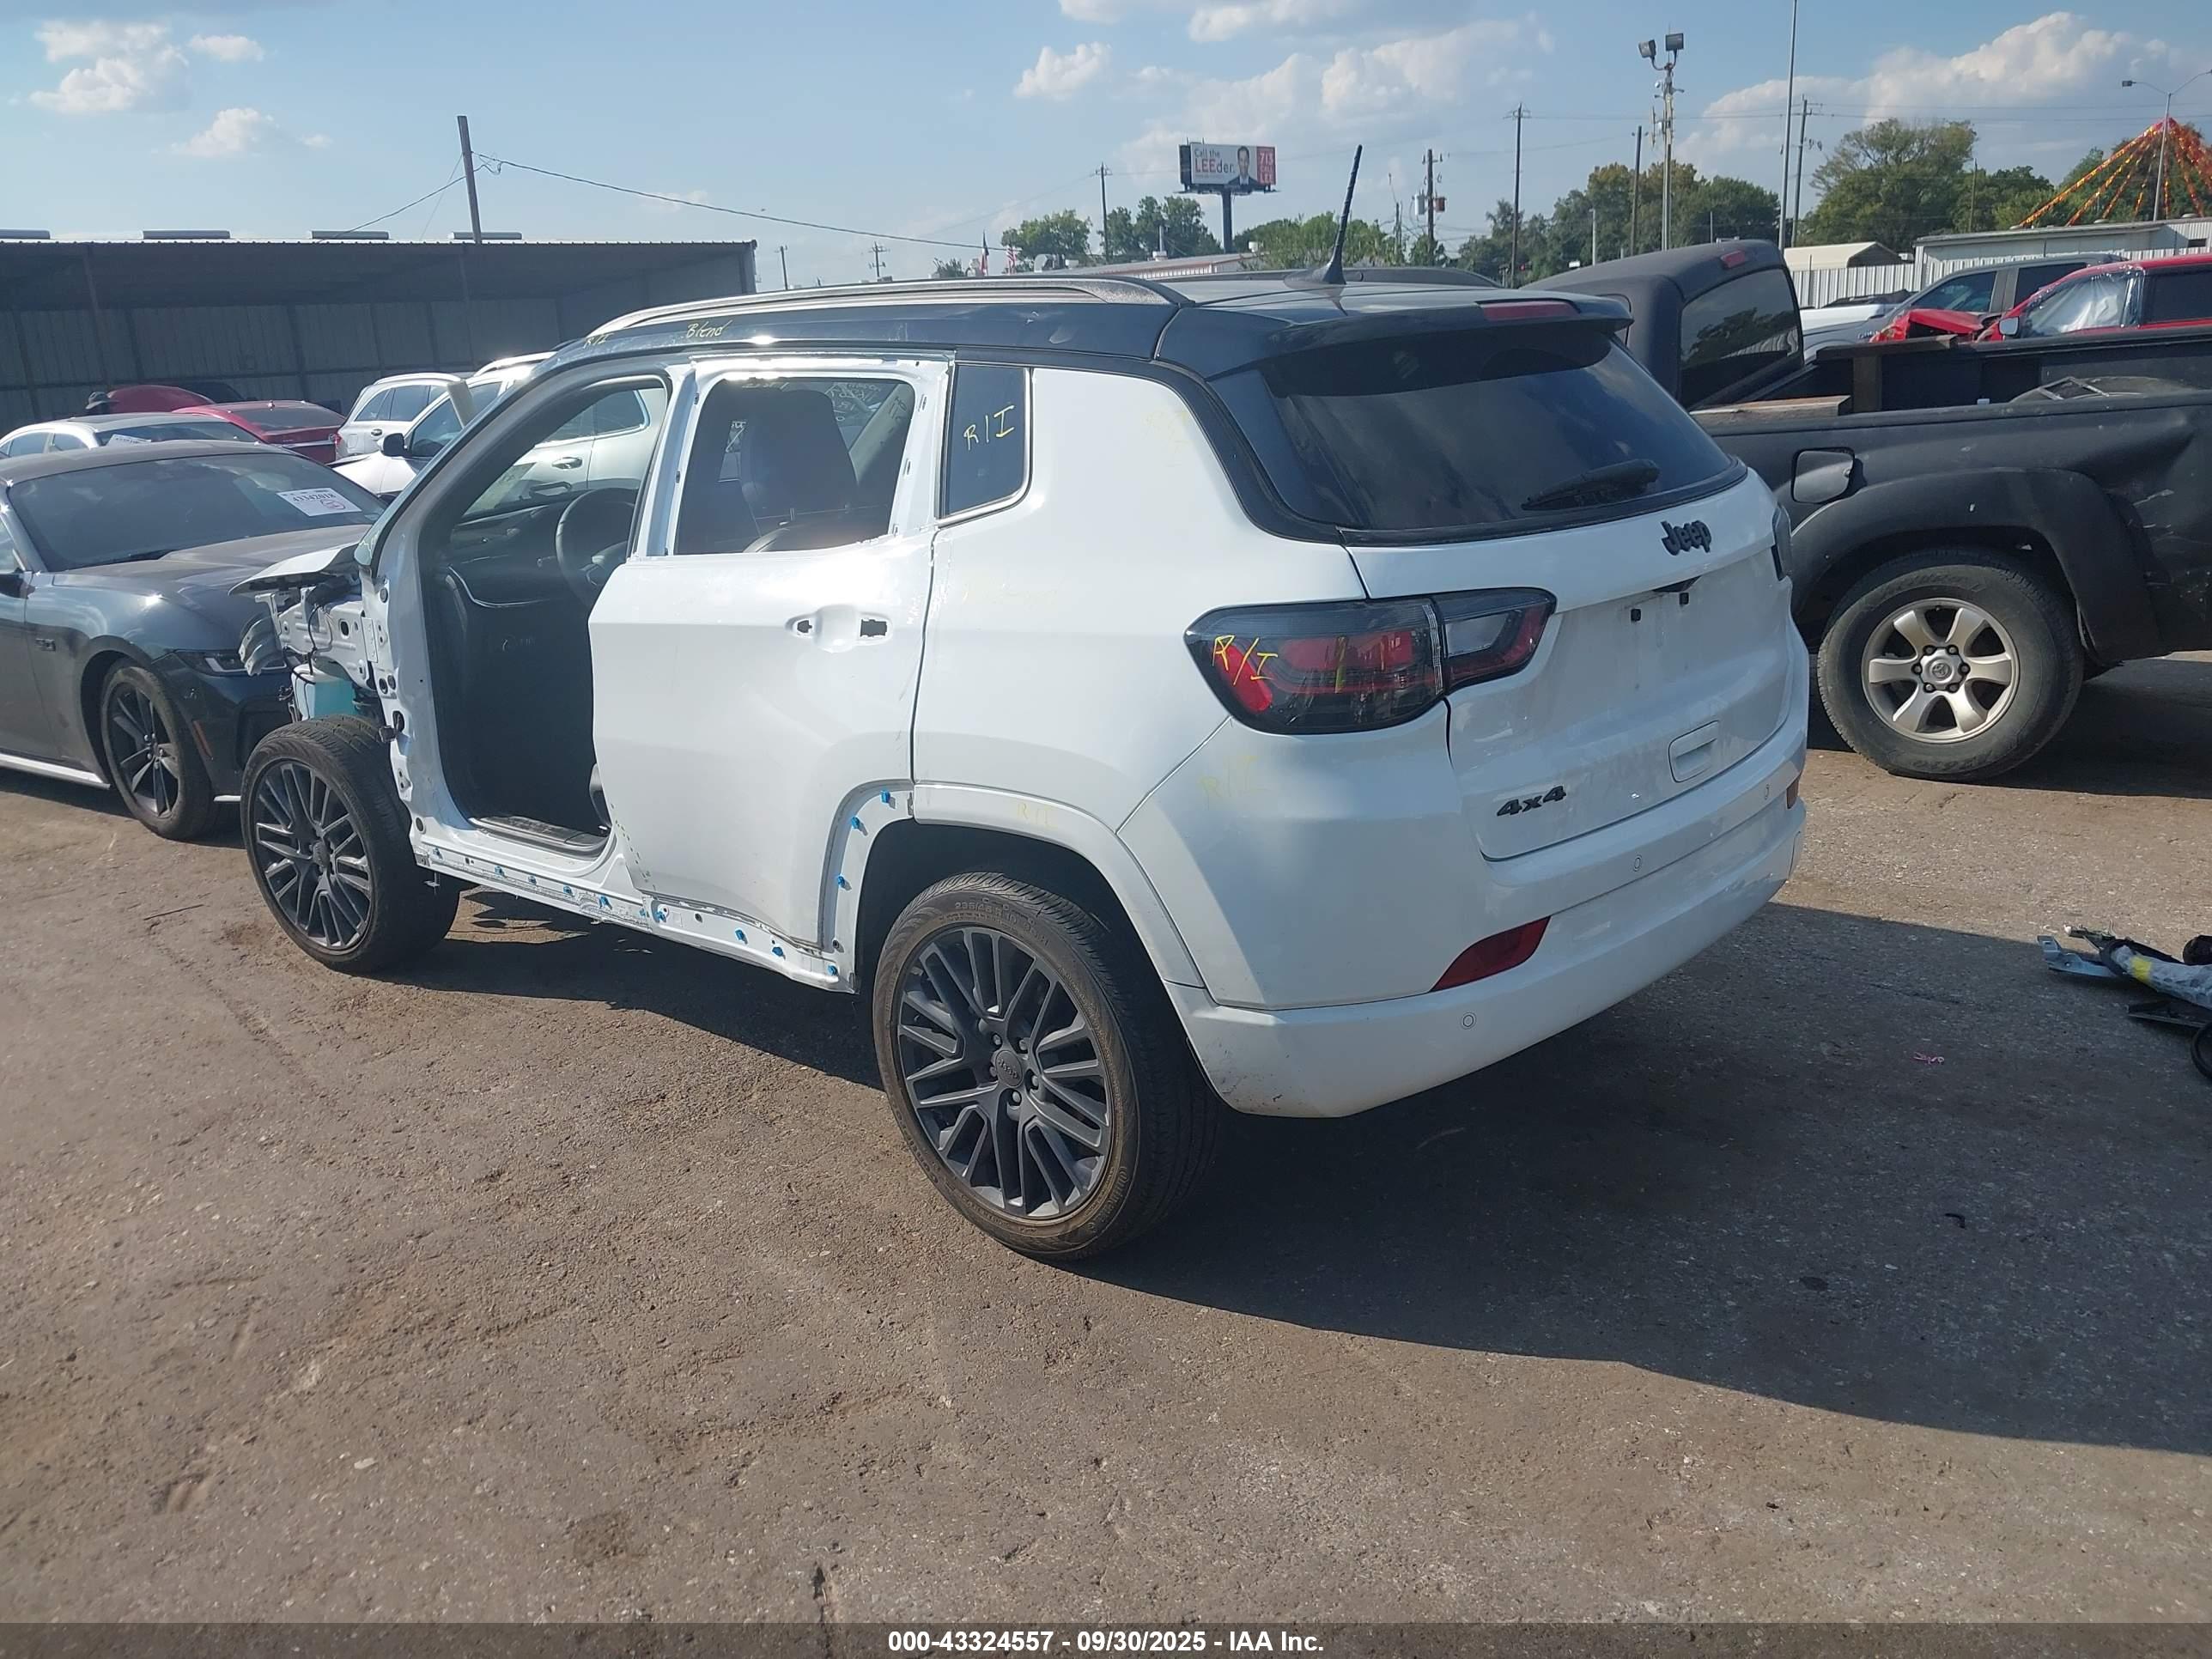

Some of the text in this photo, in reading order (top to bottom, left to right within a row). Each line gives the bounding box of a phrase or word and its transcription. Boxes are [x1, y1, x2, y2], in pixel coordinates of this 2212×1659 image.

[1194, 148, 1220, 157] Call the
[687, 320, 732, 338] Blend
[1661, 520, 1711, 556] Jeep
[1212, 635, 1279, 685] R/I
[1497, 786, 1566, 817] 4x4
